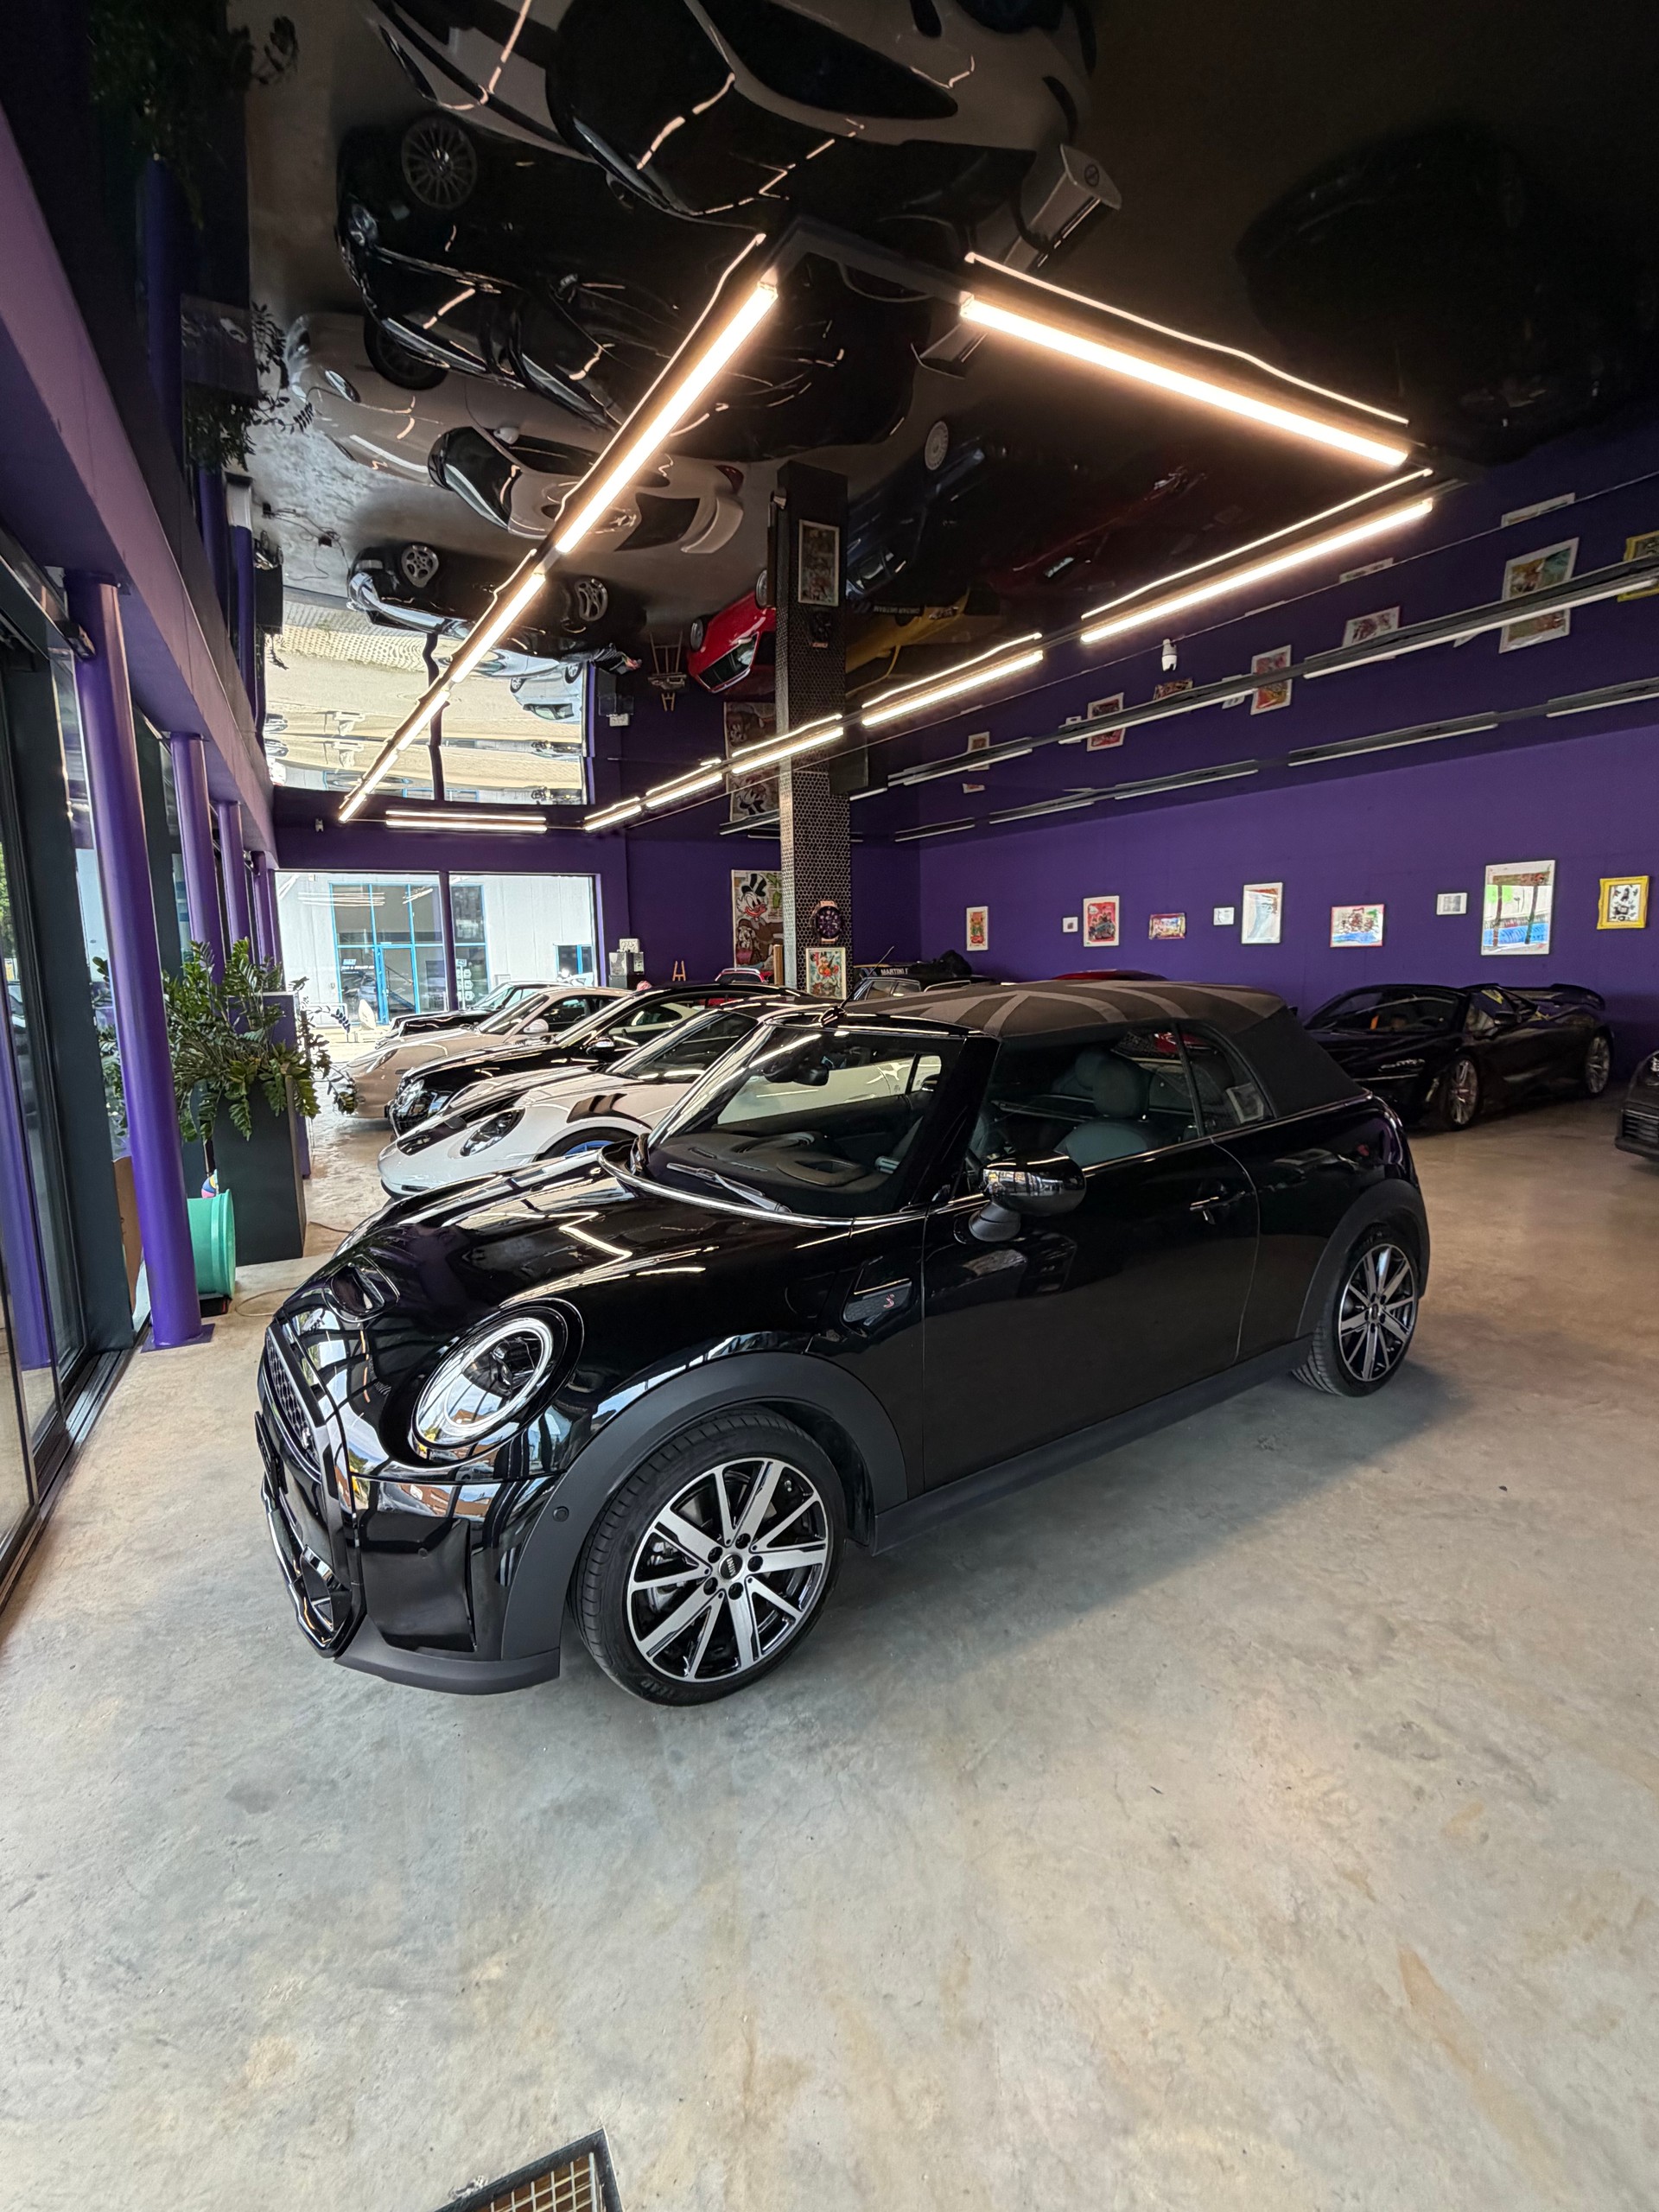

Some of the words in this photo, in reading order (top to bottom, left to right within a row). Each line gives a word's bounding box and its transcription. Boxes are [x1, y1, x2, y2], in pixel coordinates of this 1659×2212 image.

[880, 968, 905, 976] MARTINI
[883, 1294, 895, 1309] S
[726, 1556, 736, 1577] MINI
